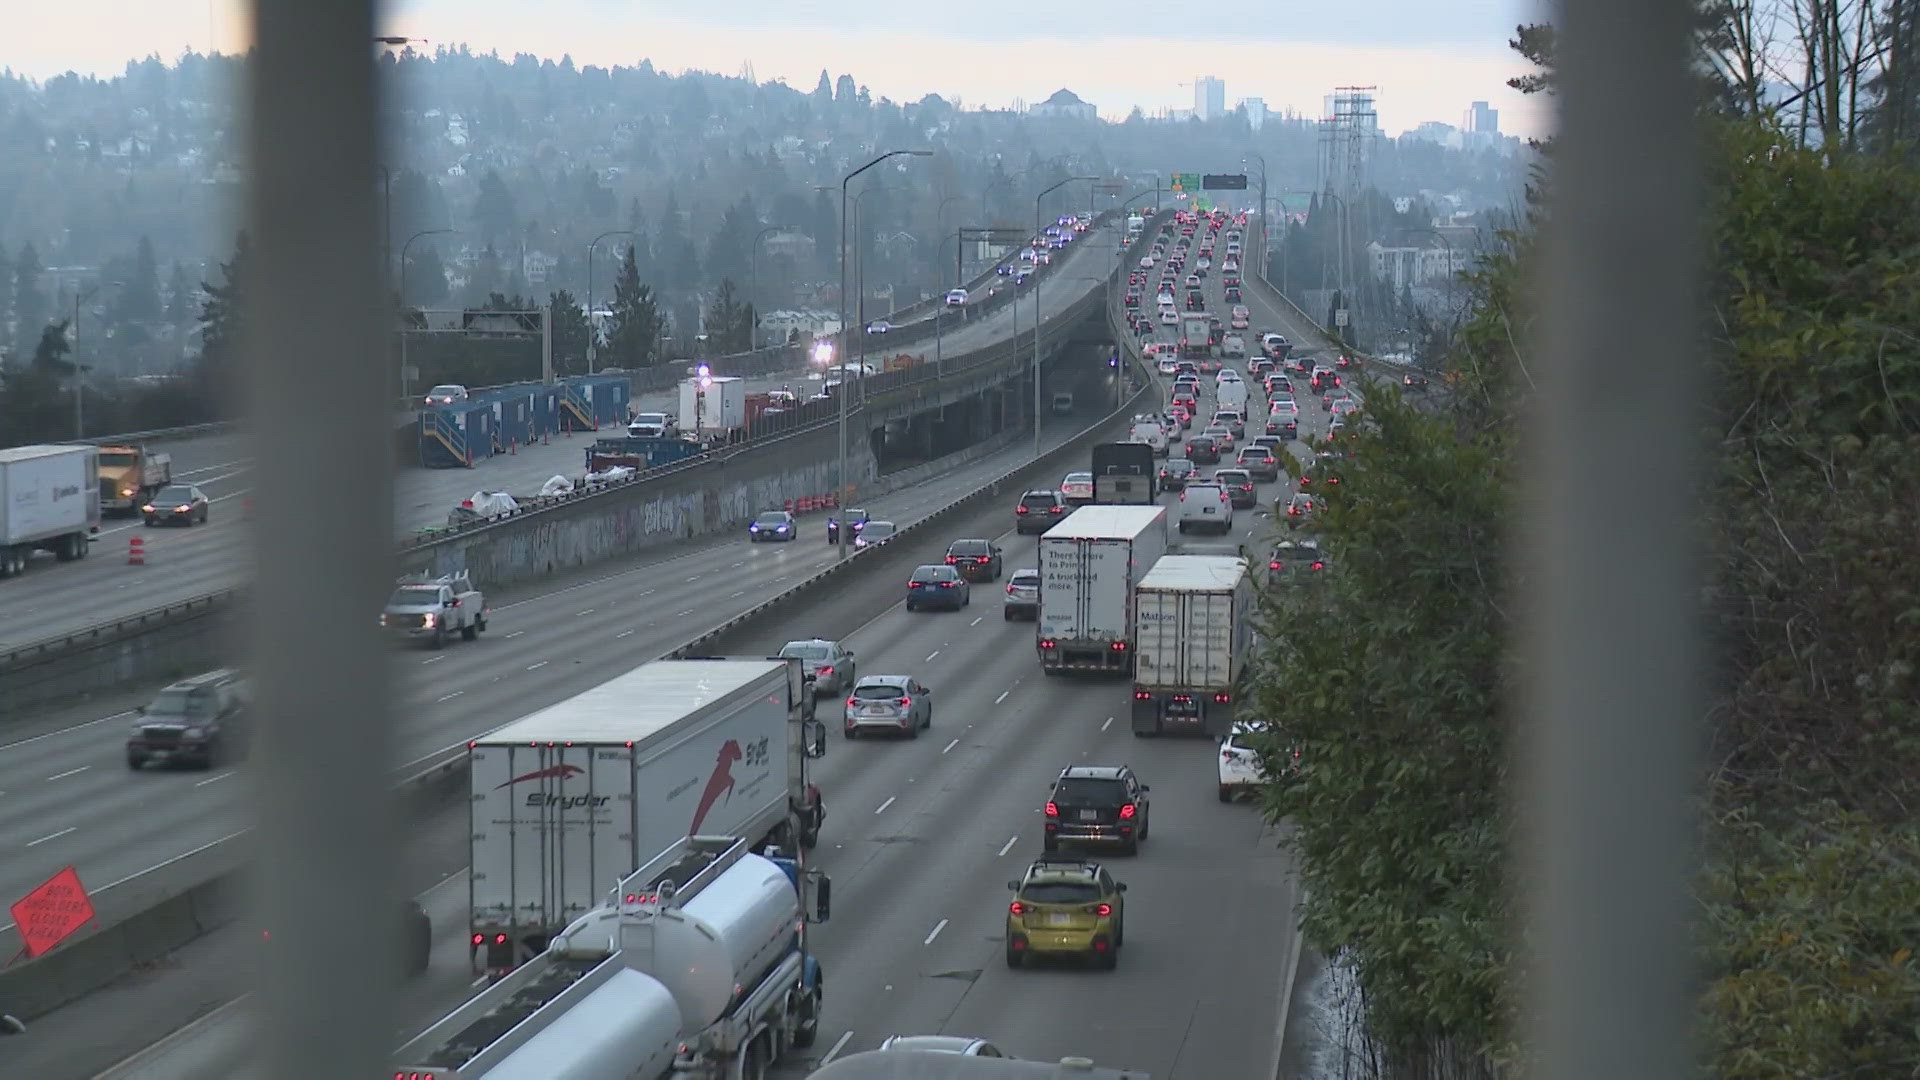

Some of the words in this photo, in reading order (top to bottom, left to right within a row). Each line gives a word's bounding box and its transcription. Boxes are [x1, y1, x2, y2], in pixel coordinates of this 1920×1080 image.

[1057, 573, 1097, 581] truckd
[1141, 612, 1175, 621] Matson
[526, 793, 610, 810] Stryder
